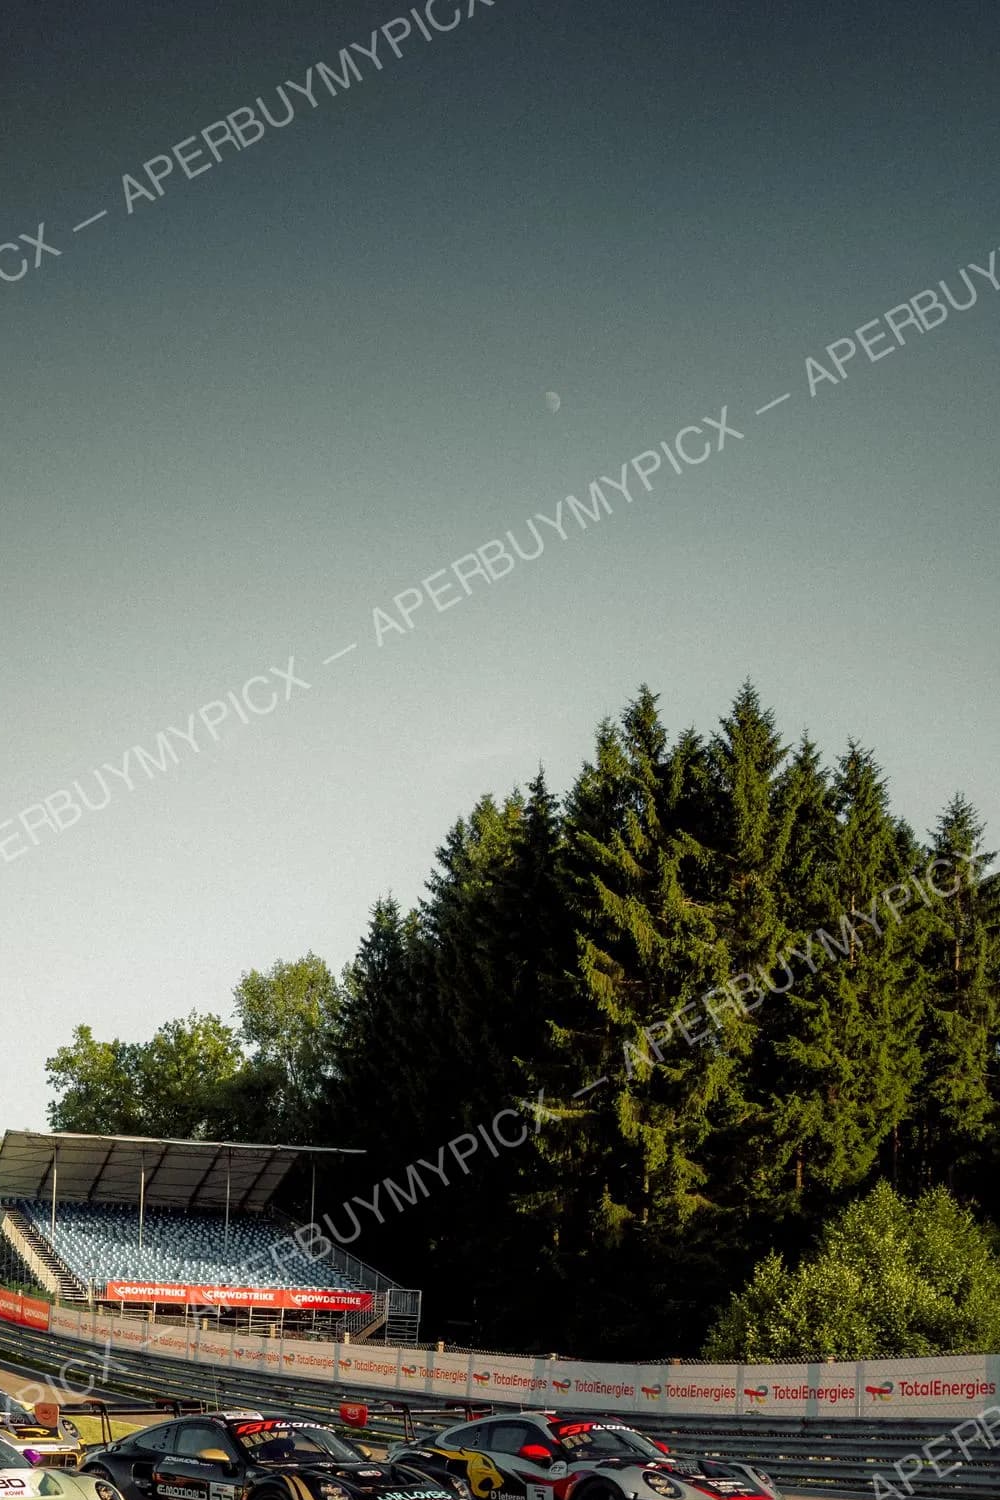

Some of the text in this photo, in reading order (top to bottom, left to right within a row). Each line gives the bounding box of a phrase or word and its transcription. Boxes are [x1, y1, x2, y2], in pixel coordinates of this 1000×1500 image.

[117, 1286, 187, 1298] CROWDSTRIKE
[206, 1289, 275, 1302] CROWDSTRIKE
[294, 1293, 362, 1306] CROWDSTRIKE
[296, 1354, 335, 1369] TotalEnergies
[353, 1359, 397, 1377] TotalEnergies
[418, 1365, 468, 1384] TotalEnergies
[493, 1372, 548, 1392] TotalEnergies
[574, 1379, 635, 1398] TotalEnergies
[664, 1384, 737, 1402] TotalEnergies
[771, 1383, 856, 1404] TotalEnergies
[899, 1378, 997, 1402] TotalEnergies
[403, 1490, 453, 1500] LOVERS
